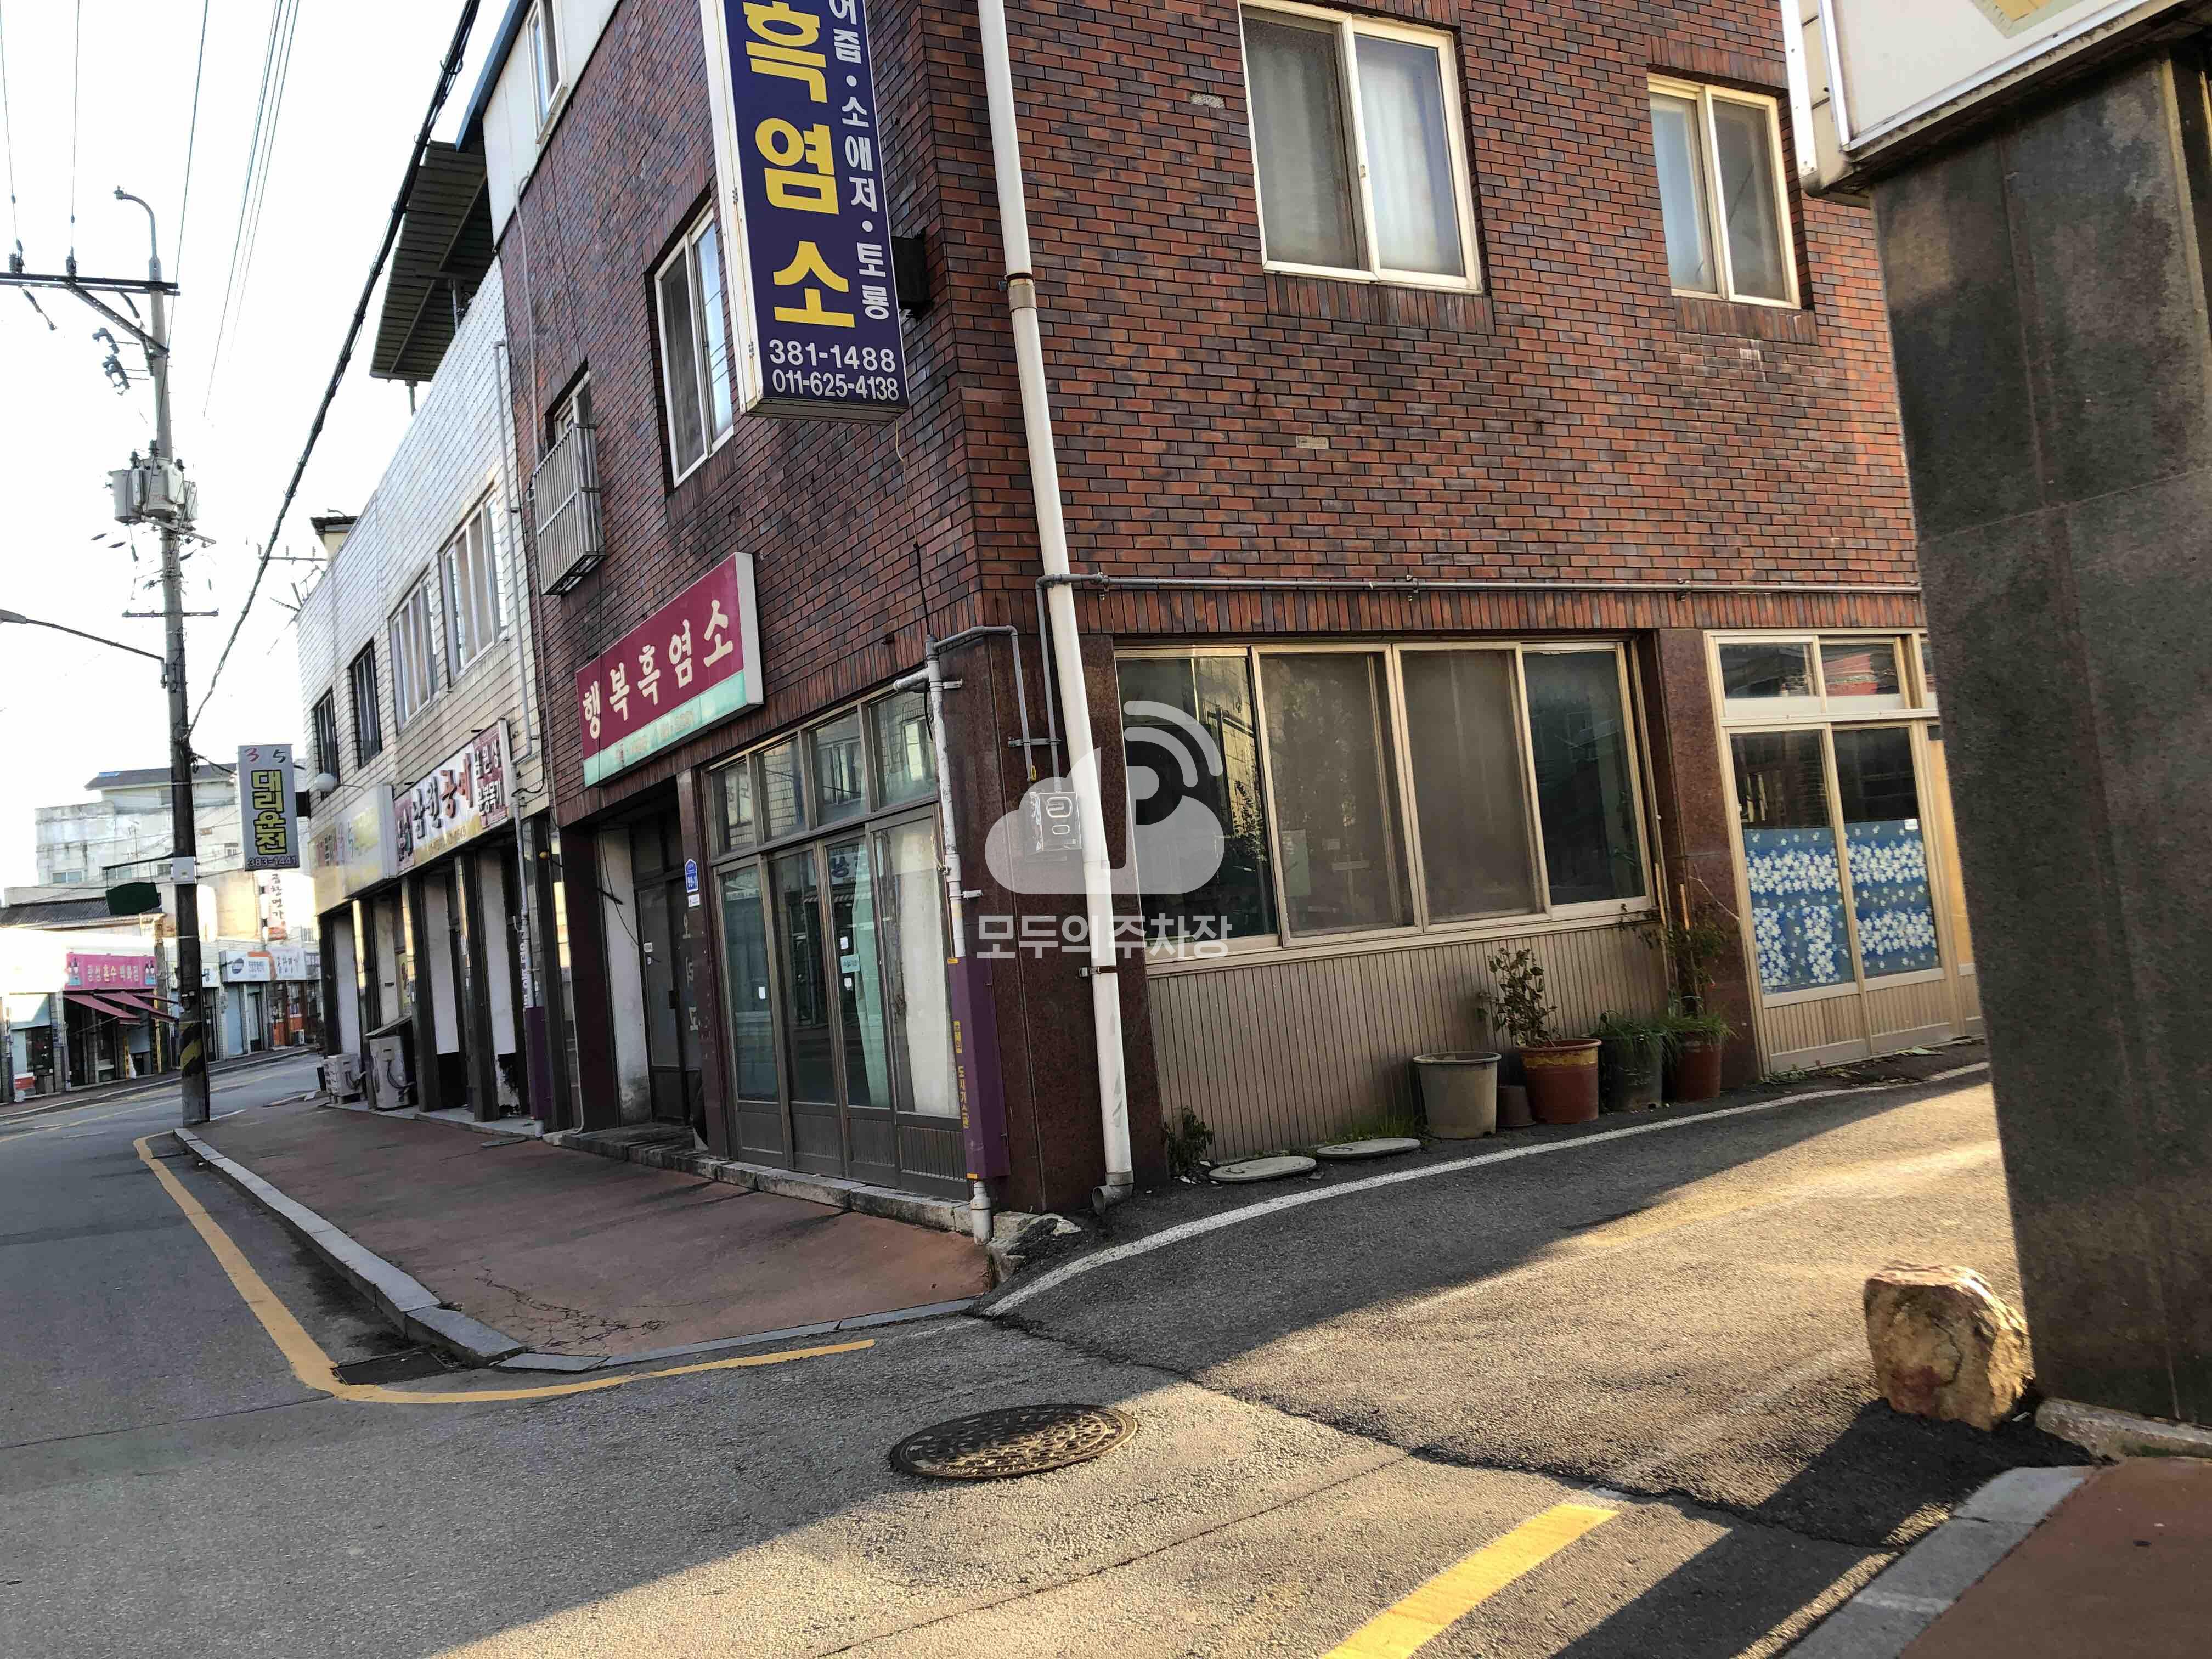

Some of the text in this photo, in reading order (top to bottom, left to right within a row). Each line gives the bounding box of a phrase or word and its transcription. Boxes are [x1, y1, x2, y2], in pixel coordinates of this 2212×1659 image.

[743, 2, 855, 328] 흑염소
[769, 339, 896, 373] 381-1488
[772, 369, 899, 402] 011-625-4138
[583, 600, 733, 740] 행복흑염소
[245, 748, 259, 763] 3
[251, 769, 287, 855] 대리운전
